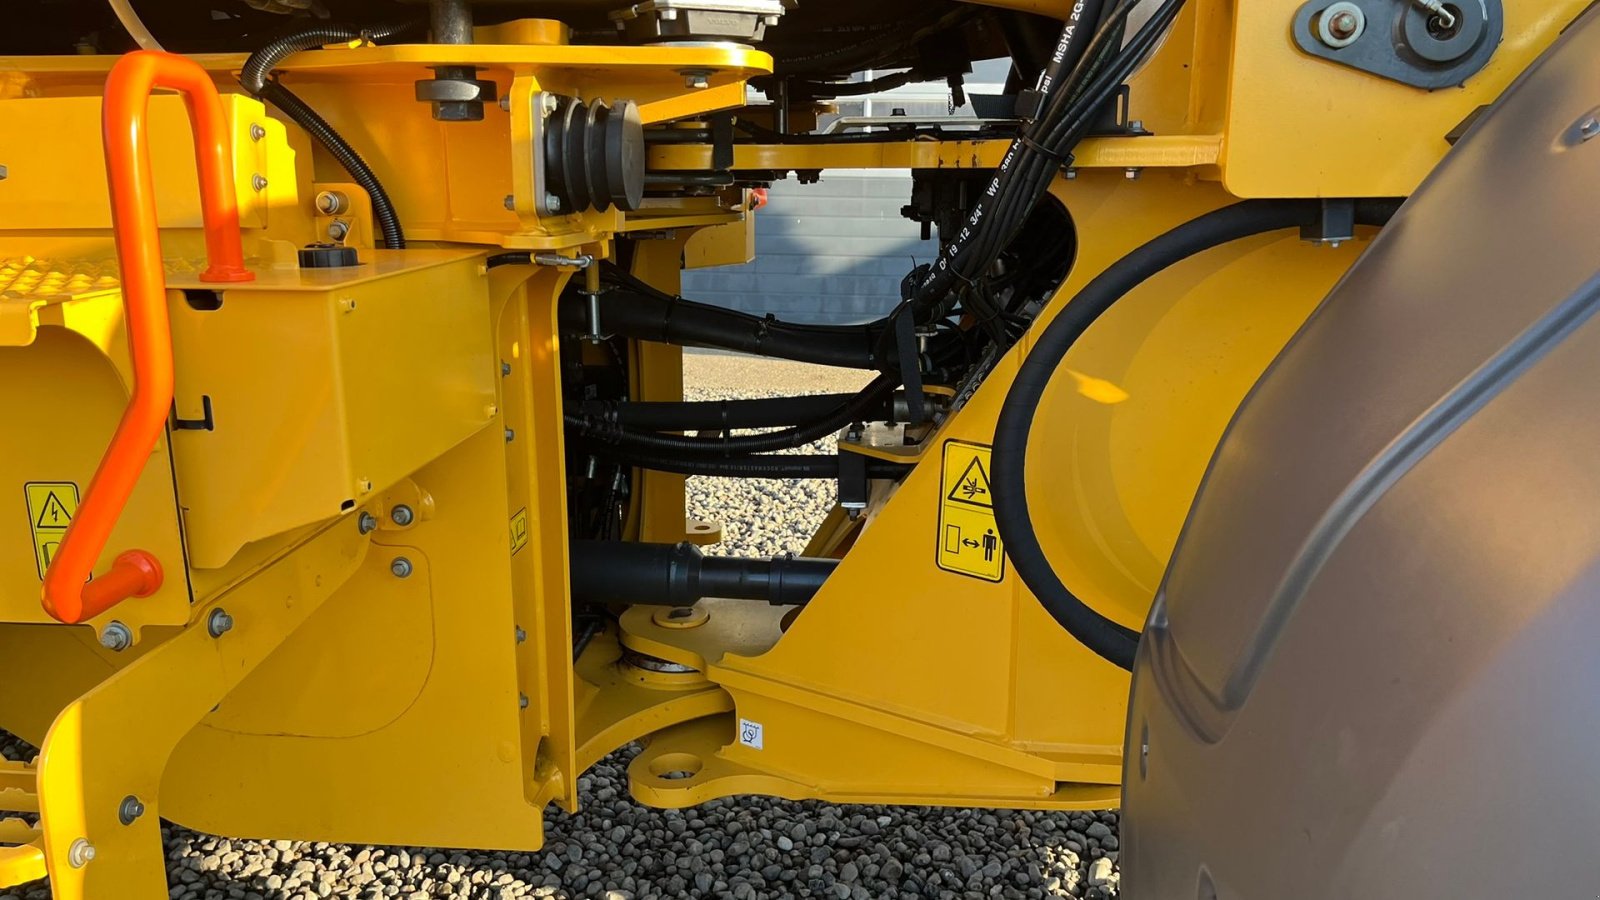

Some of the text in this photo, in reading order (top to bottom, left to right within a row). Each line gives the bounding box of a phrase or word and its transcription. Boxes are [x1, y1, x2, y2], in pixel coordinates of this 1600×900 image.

[959, 227, 970, 243] -12
[969, 203, 983, 226] 3/4"
[986, 177, 1000, 197] WP
[1040, 76, 1053, 94] psi
[1052, 25, 1076, 64] MSHA
